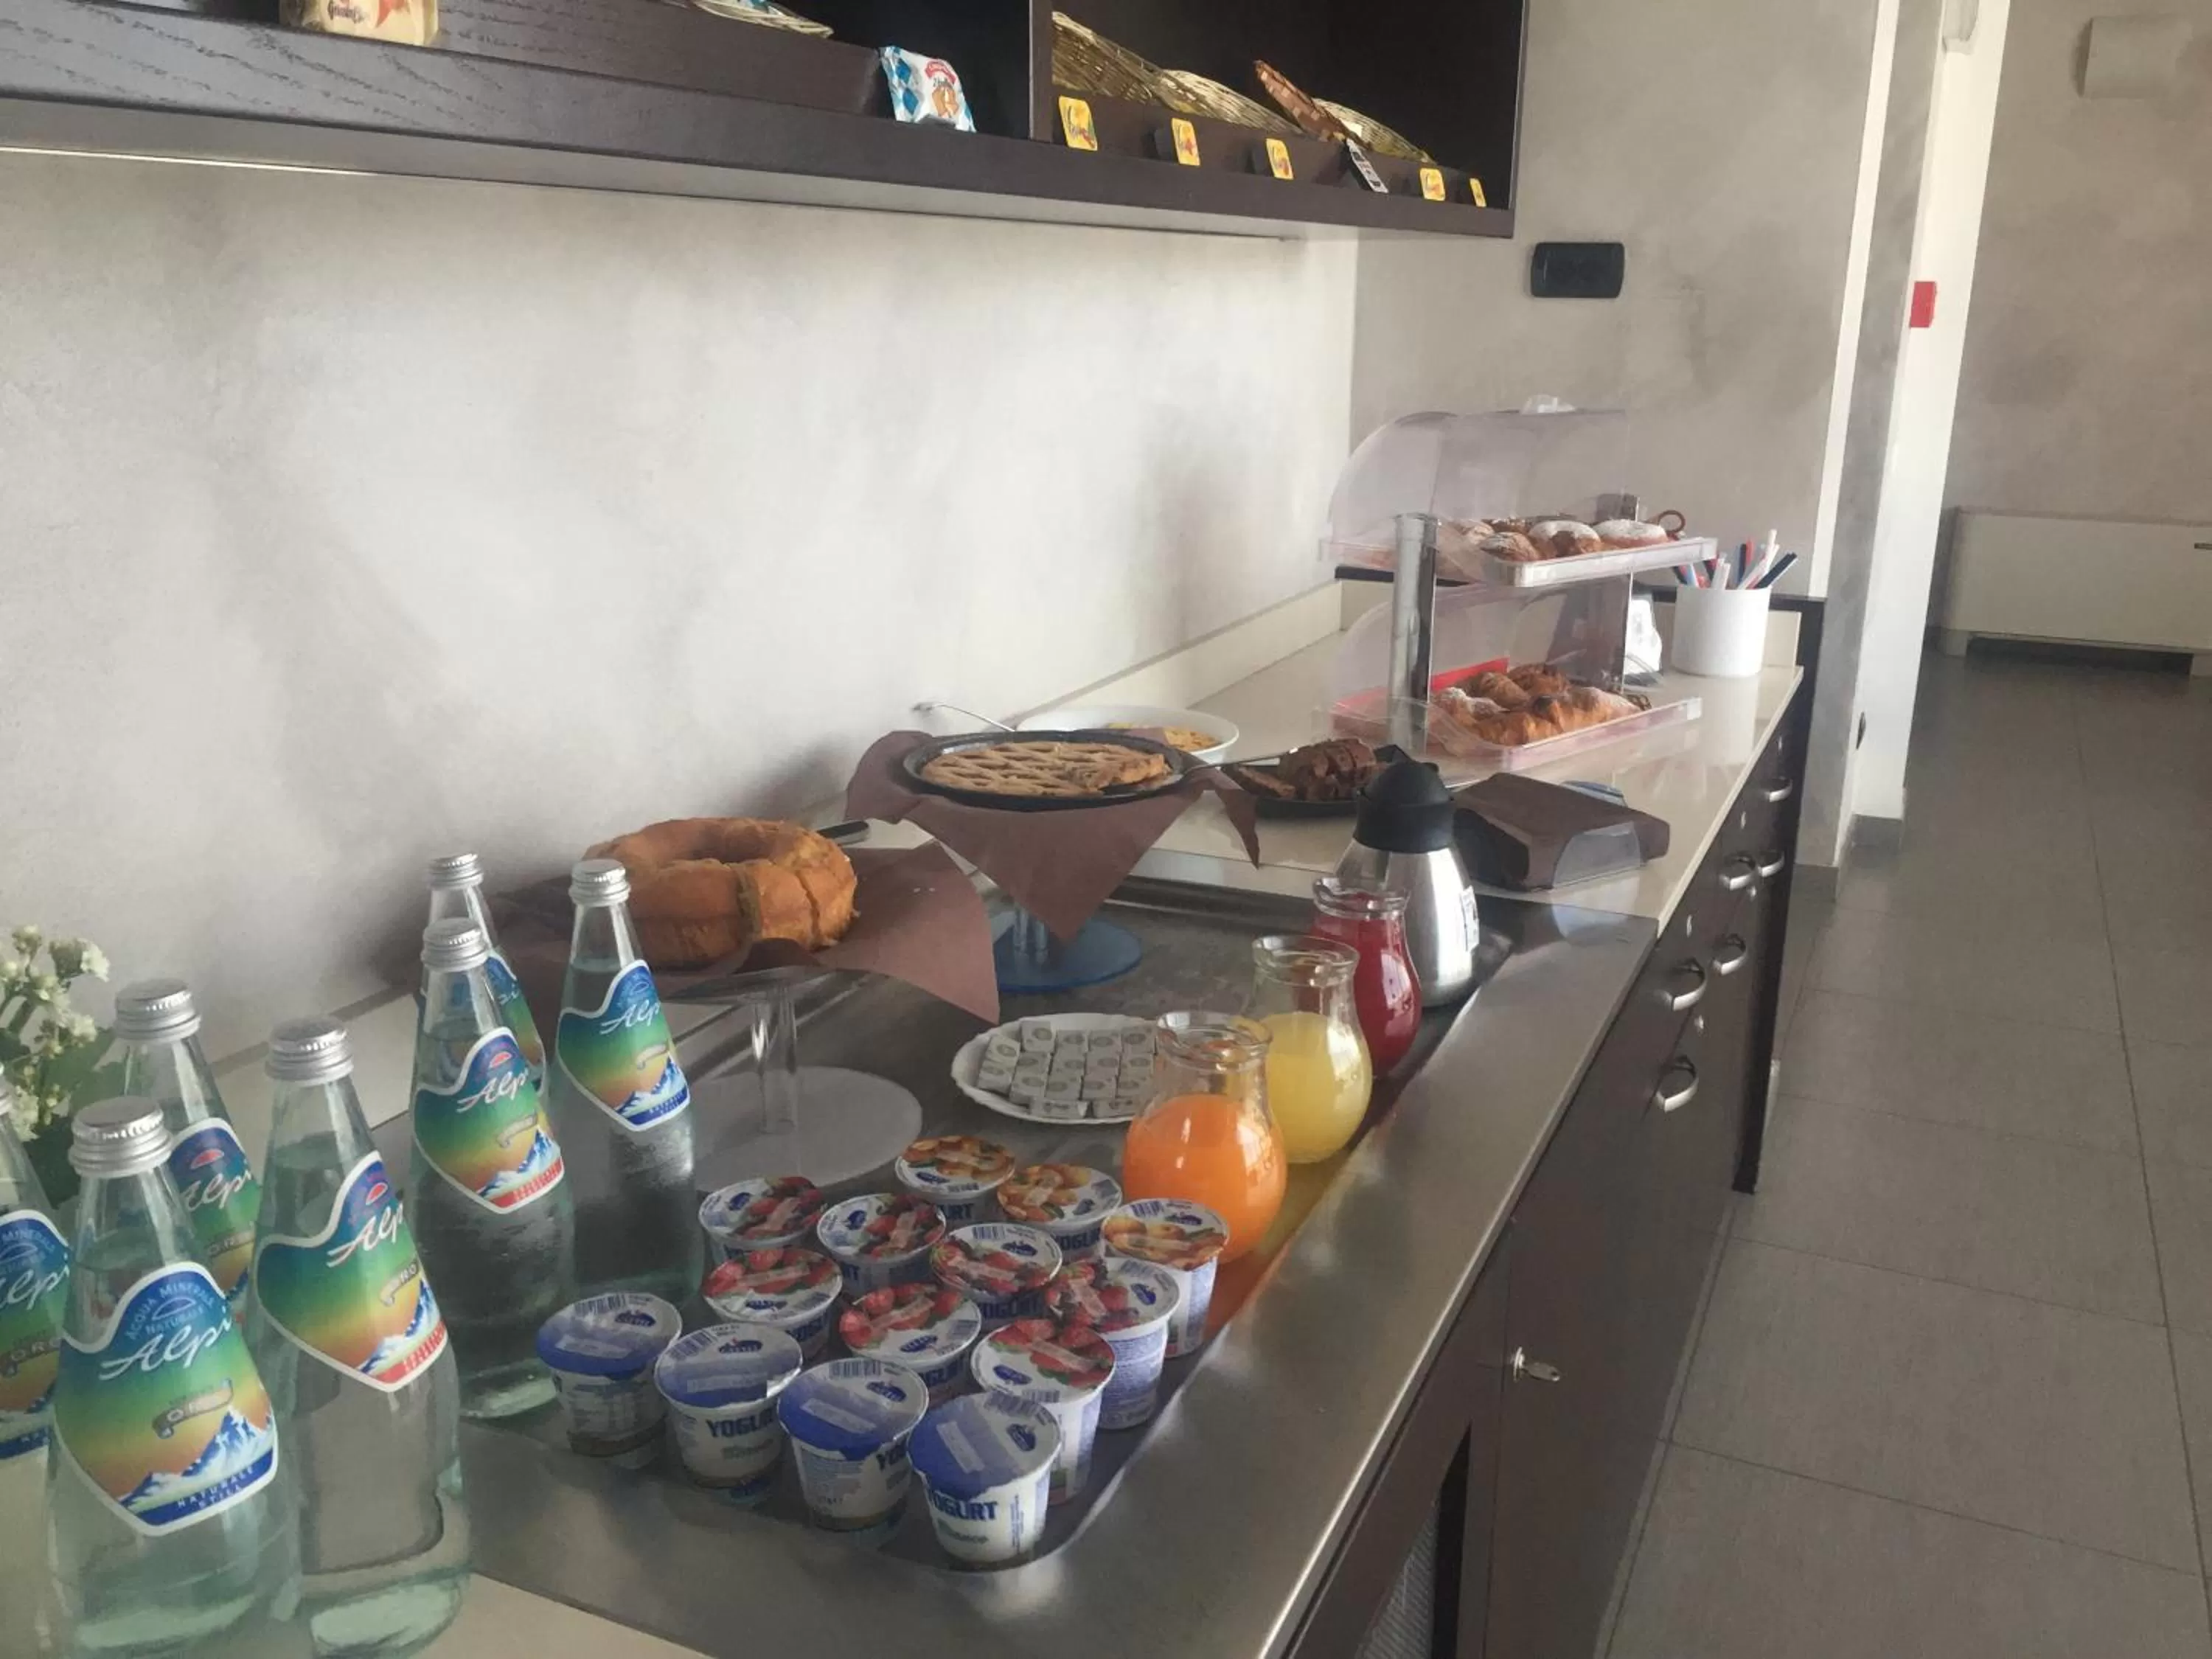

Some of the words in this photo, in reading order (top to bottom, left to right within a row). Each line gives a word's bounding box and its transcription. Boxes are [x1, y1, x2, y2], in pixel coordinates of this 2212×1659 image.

[0, 1251, 70, 1310] lpi
[125, 1298, 157, 1340] ACQUA
[159, 1281, 215, 1309] MINERALE
[706, 1408, 774, 1439] YOGUR
[176, 1464, 254, 1509] NATURALE
[931, 1491, 998, 1521] OGURT
